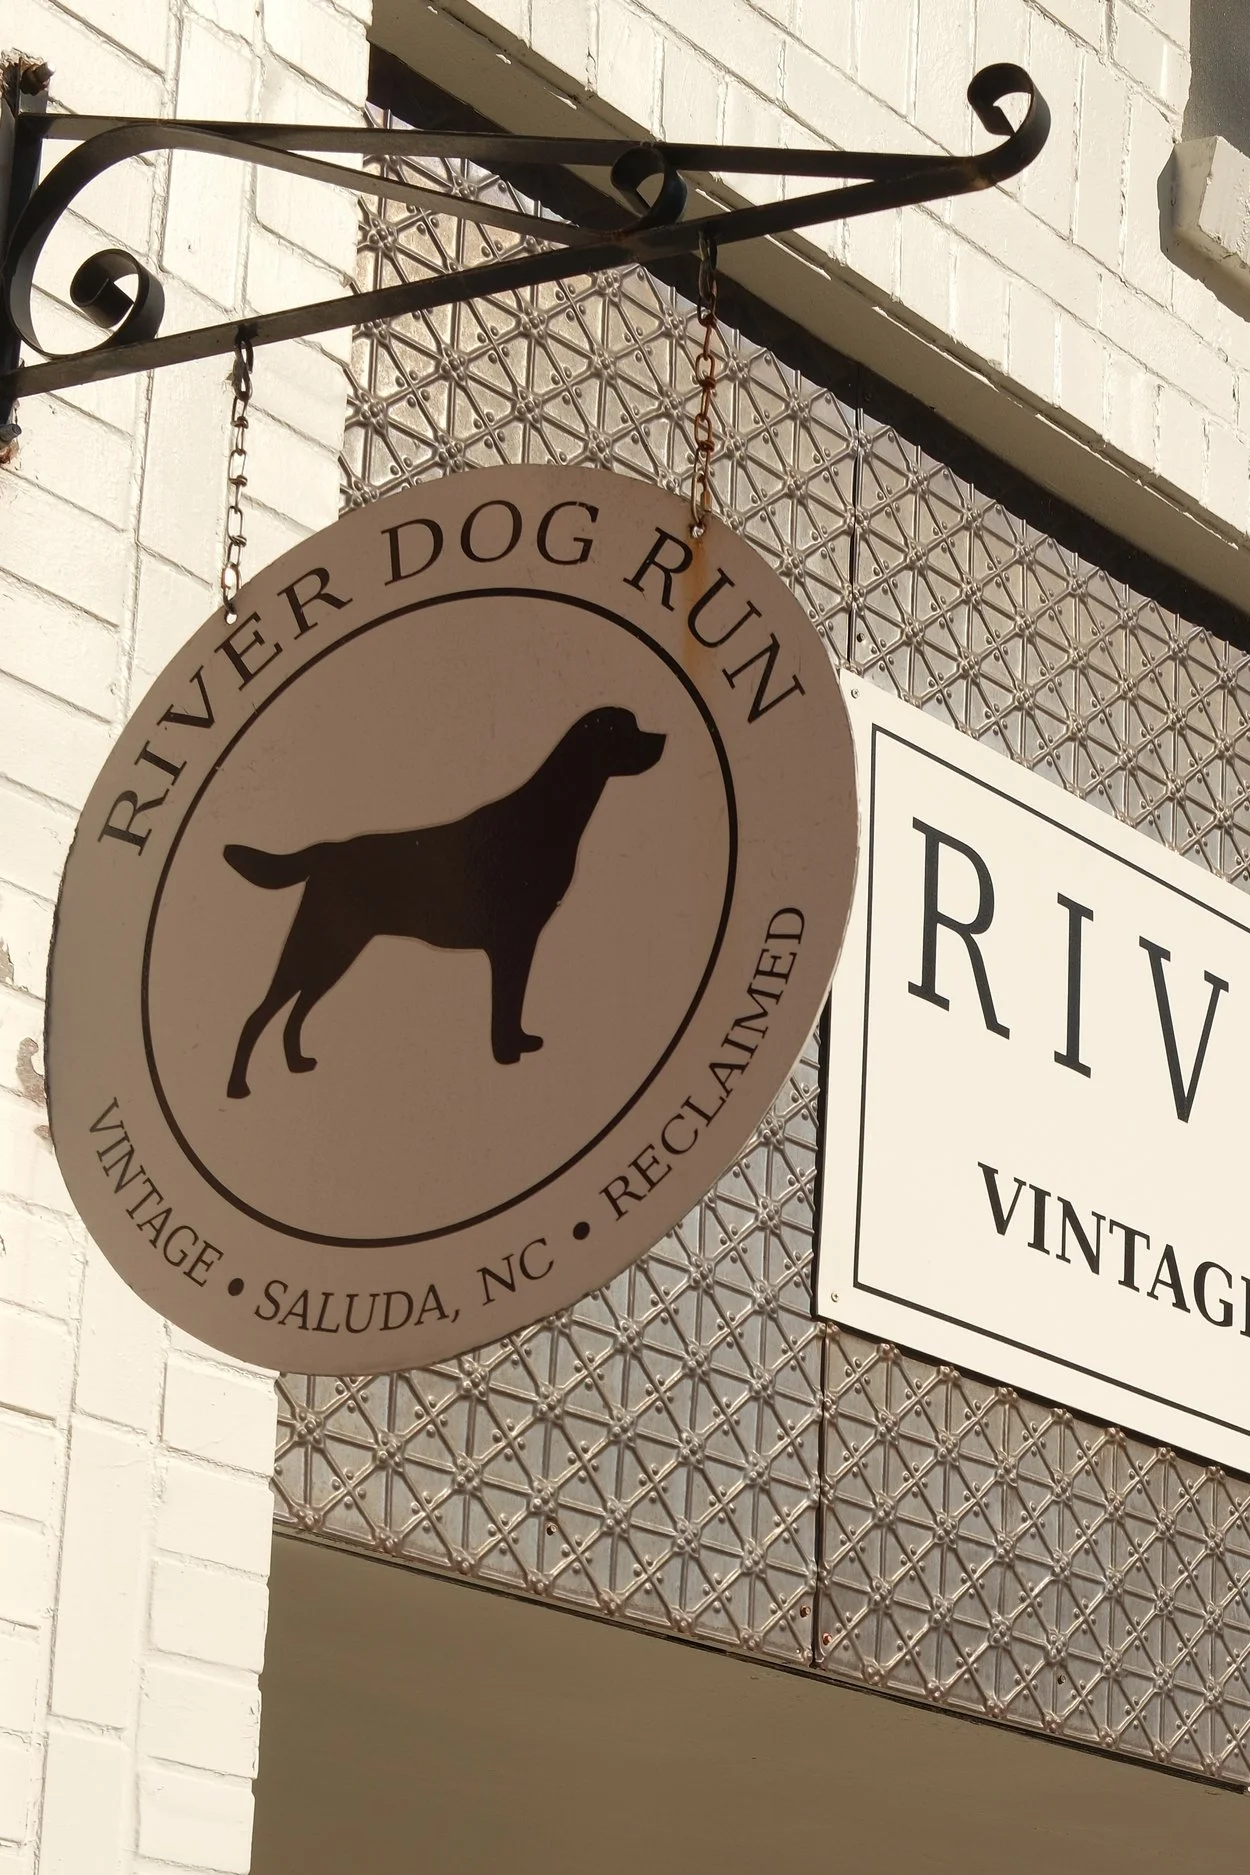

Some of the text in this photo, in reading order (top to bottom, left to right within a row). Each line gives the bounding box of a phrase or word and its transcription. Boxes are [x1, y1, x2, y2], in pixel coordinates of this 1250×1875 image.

[98, 499, 806, 857] RIVER DOG RUN
[85, 905, 806, 1336] VINTAGE SALUDA, NC RECLAIMED
